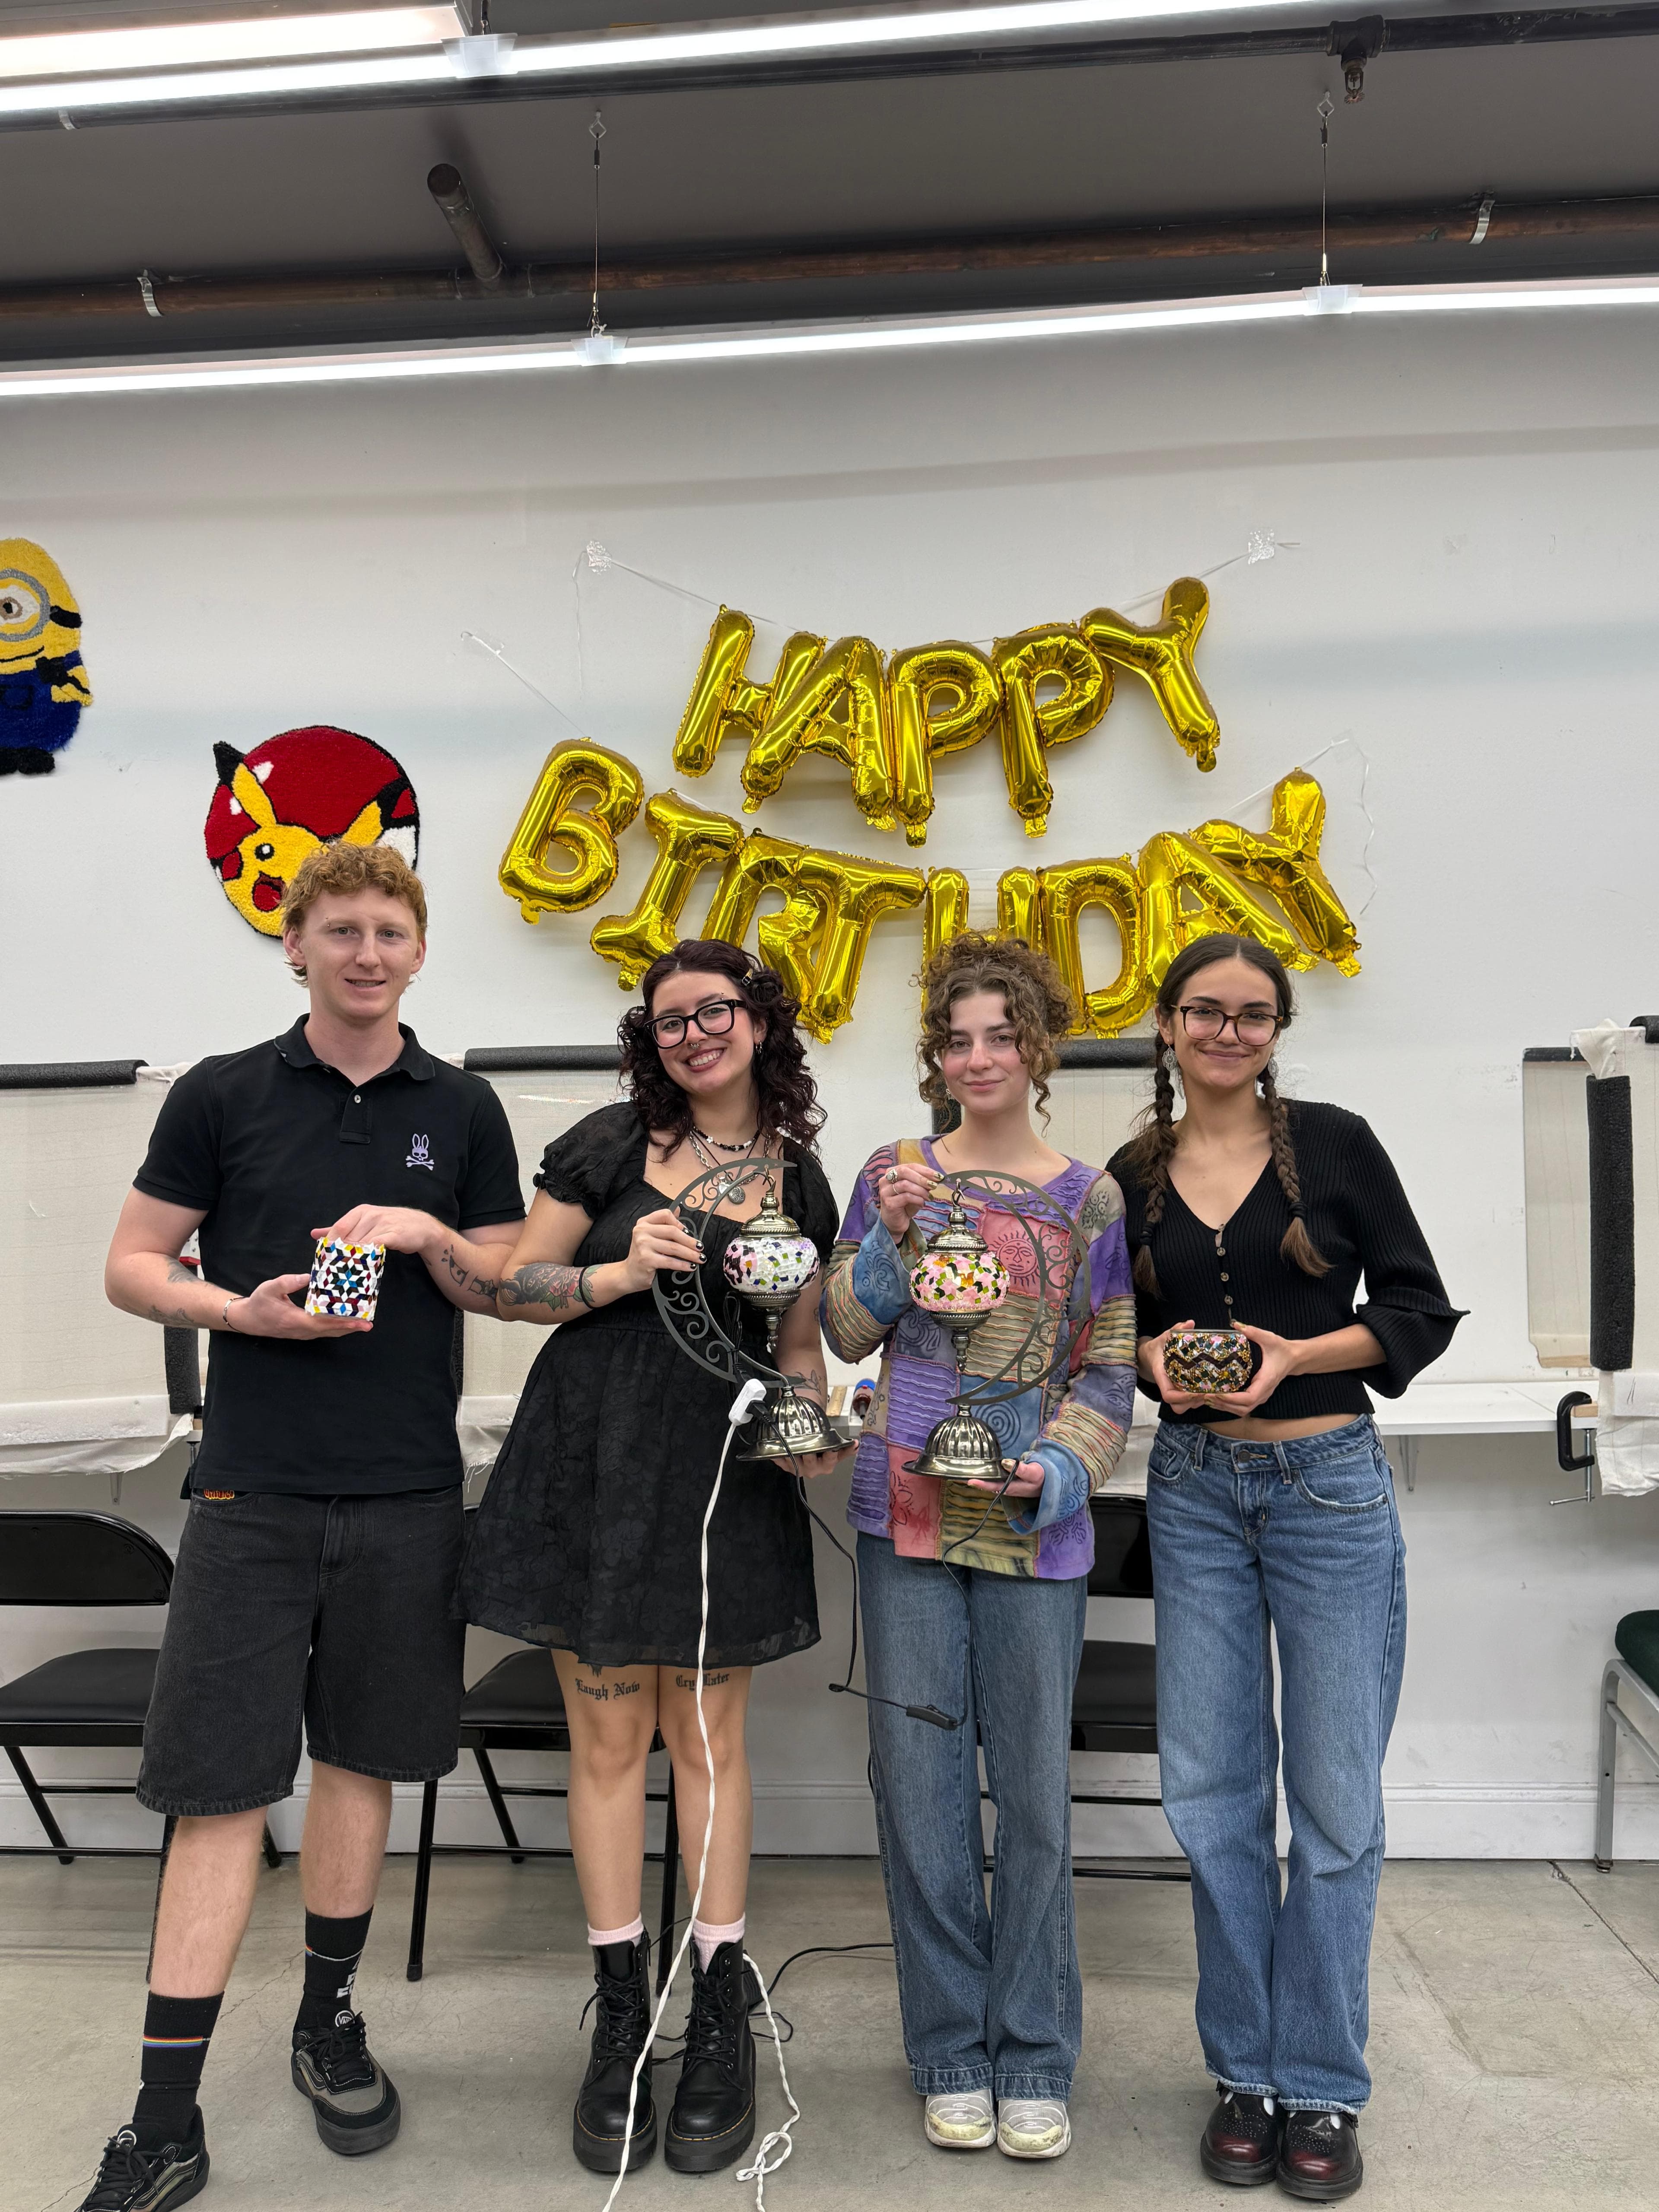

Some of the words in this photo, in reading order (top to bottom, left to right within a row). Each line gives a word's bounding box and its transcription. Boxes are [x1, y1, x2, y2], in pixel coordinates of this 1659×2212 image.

[672, 576, 1220, 847] HAPPY
[575, 1678, 608, 1700] Laugh
[613, 1681, 640, 1700] Now
[676, 1674, 695, 1691] Cry
[702, 1672, 730, 1689] Later
